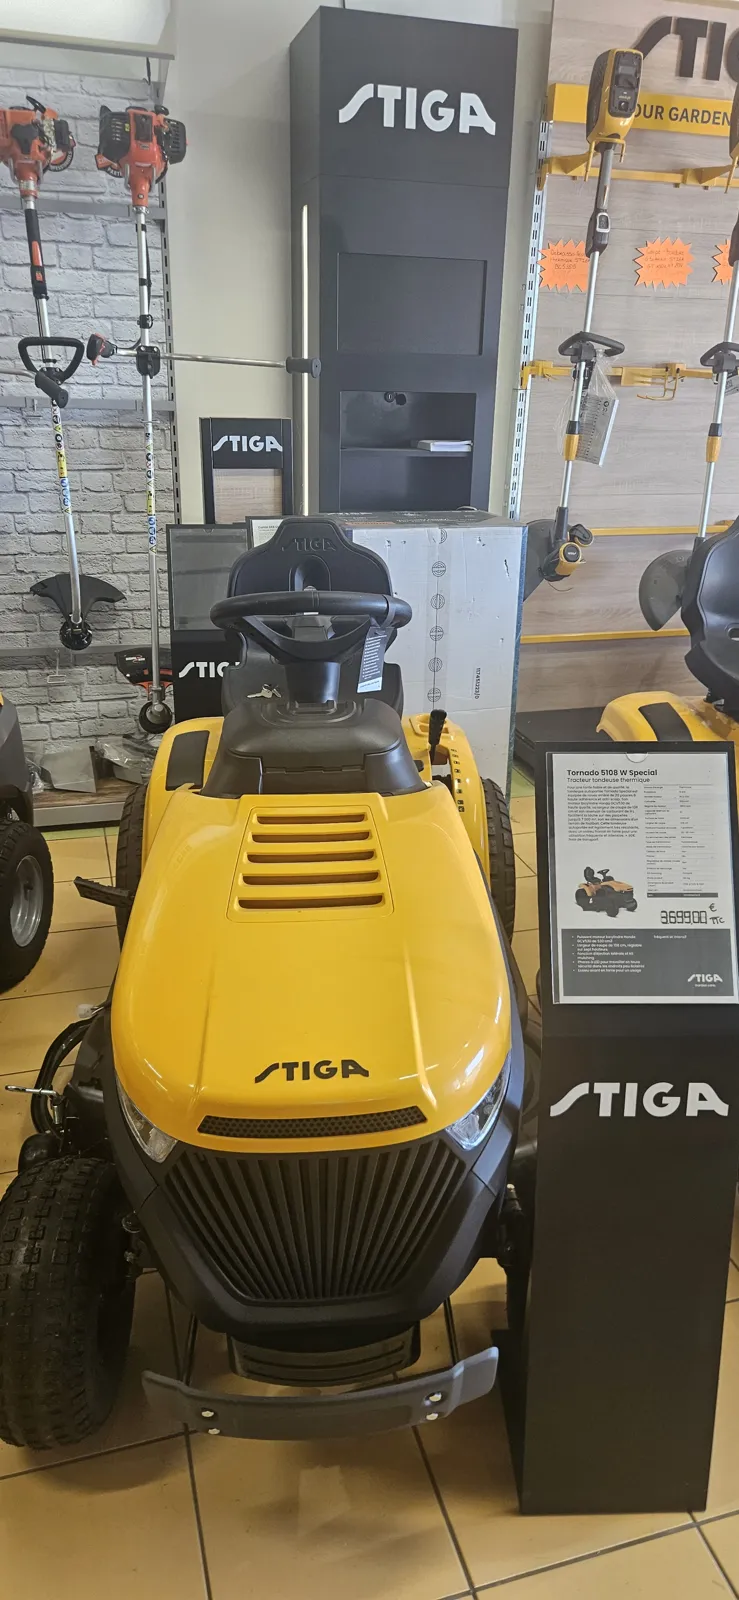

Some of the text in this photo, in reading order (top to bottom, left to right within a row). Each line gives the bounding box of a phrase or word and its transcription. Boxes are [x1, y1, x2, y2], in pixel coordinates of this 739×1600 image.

[633, 16, 739, 82] STI
[338, 83, 496, 136] STIGA
[668, 107, 731, 126] GARDEN
[213, 435, 283, 452] STIGA
[281, 538, 336, 552] STIGA
[179, 661, 240, 678] STI
[688, 974, 723, 982] STIGA
[255, 1059, 369, 1083] STIGA
[550, 1082, 729, 1117] STIGA
